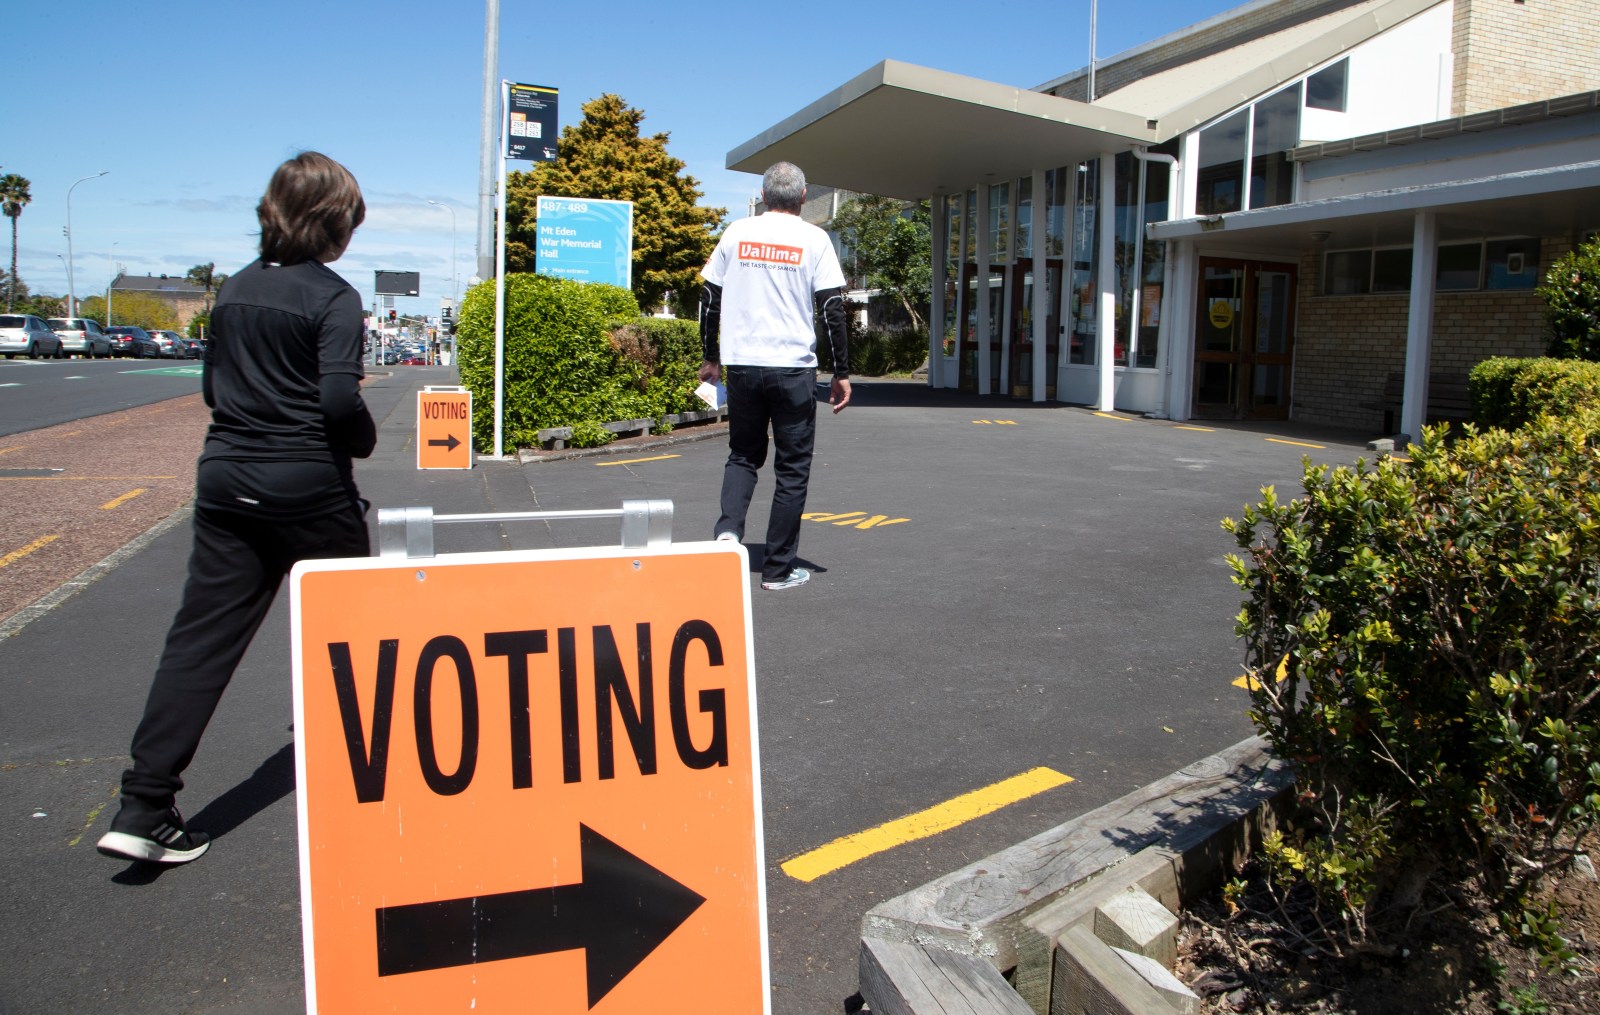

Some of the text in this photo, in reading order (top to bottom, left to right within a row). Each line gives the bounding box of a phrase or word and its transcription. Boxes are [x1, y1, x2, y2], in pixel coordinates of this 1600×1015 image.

[540, 226, 577, 236] Mt Eden
[540, 237, 602, 249] War Memorial
[540, 249, 558, 258] Hall
[741, 244, 800, 262] Vailima
[423, 401, 467, 420] VOTING
[327, 619, 729, 804] VOTING
